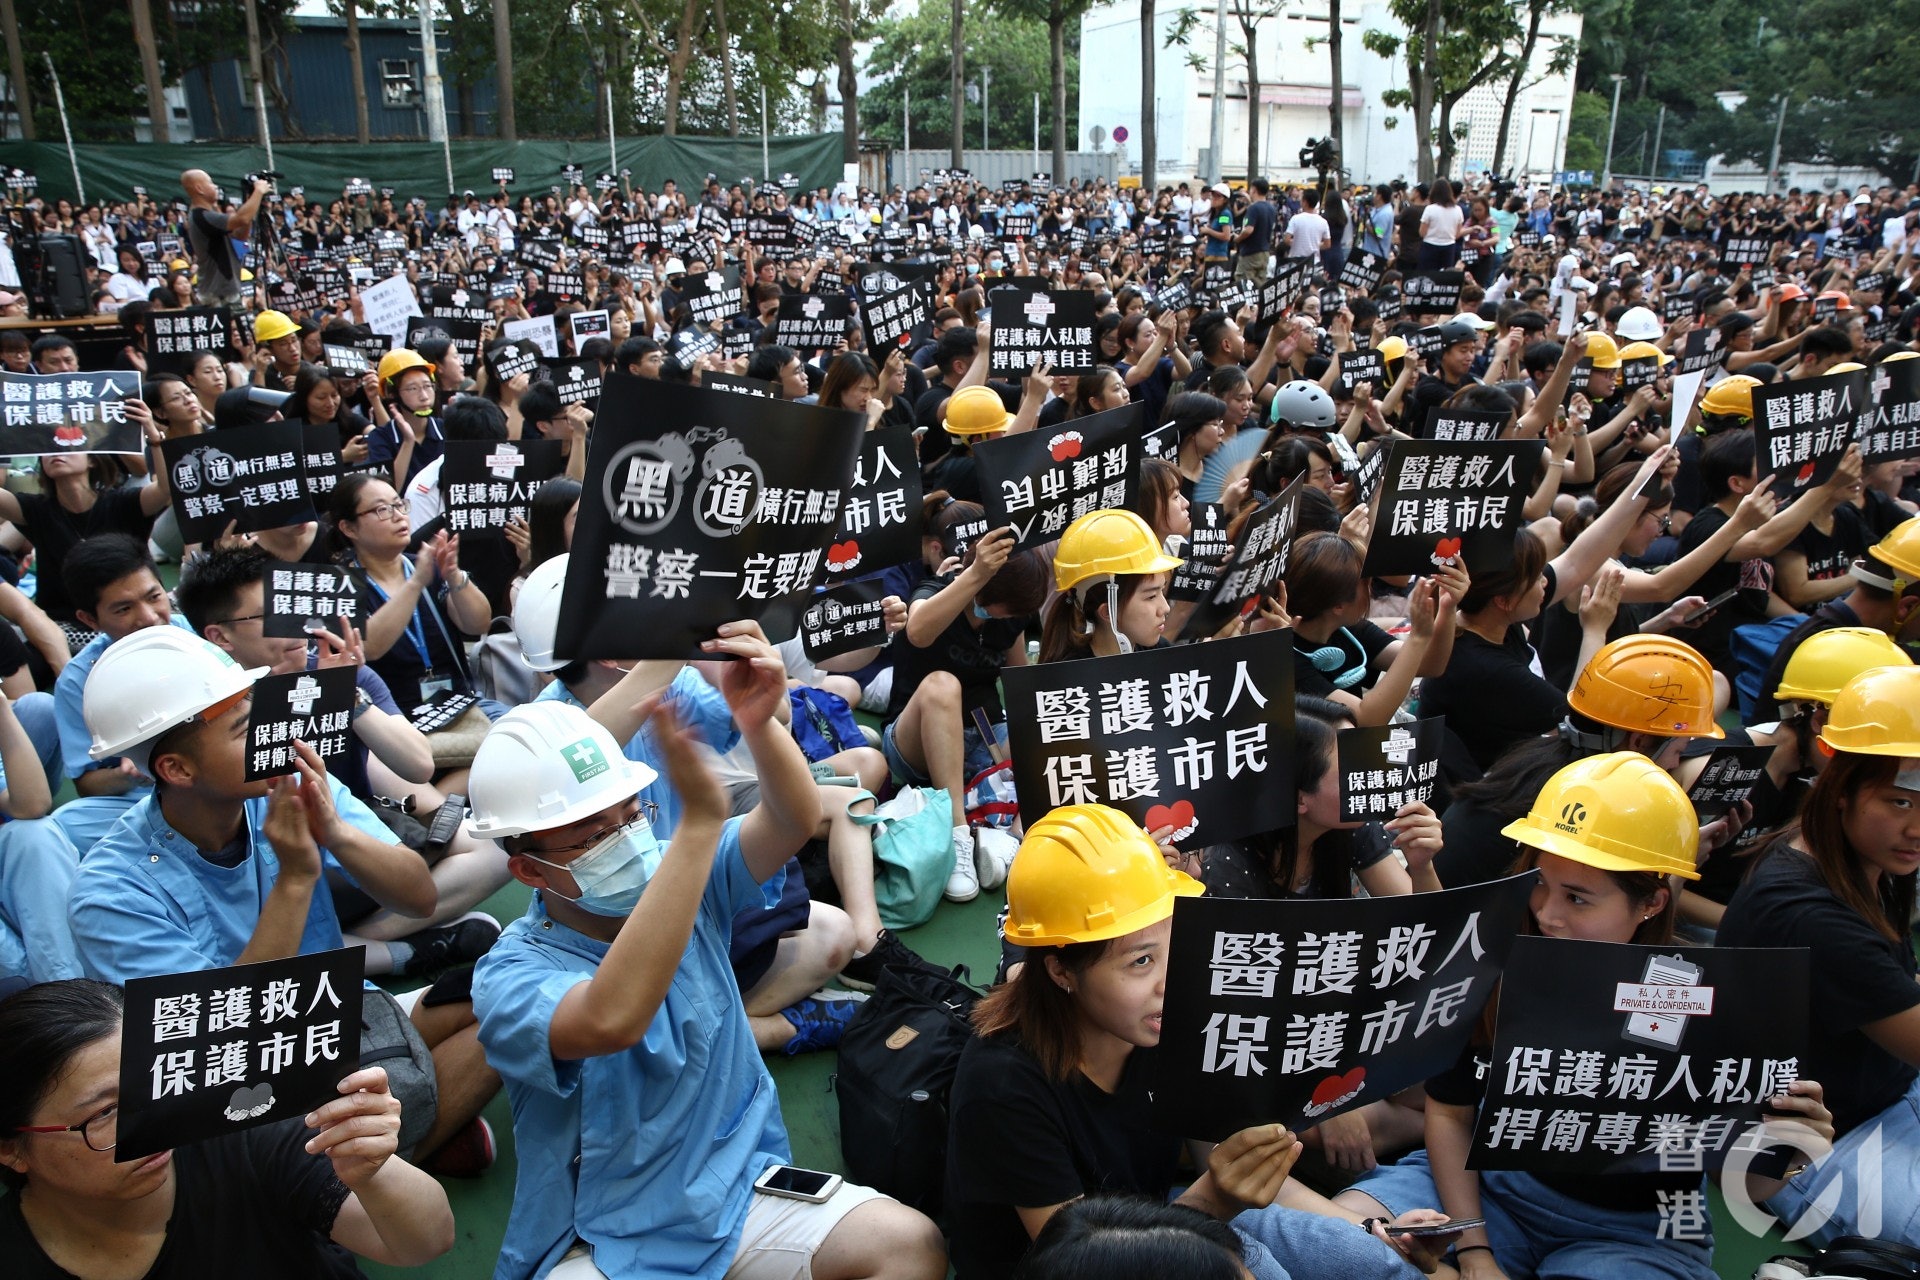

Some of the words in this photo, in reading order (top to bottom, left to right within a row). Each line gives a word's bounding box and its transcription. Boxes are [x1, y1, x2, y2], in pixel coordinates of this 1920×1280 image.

[154, 313, 224, 335] 醫護救人
[868, 287, 922, 327] 醫護救人
[156, 334, 225, 353] 保護市民
[873, 305, 926, 346] 保護市民
[993, 326, 1093, 347] 保護病人私隱
[992, 348, 1093, 370] 捍衛專業自主
[3, 378, 125, 402] 醫護救人
[1766, 385, 1853, 430] 醫護救人
[3, 400, 128, 426] 保護市民
[303, 452, 336, 469] 無忌
[1769, 422, 1849, 469] 保護市民
[177, 452, 296, 490] 黑道橫行無忌
[1397, 453, 1517, 492] 醫護救人
[184, 479, 300, 519] 警察一定要理
[449, 481, 547, 506] 保護病人私
[617, 456, 841, 525] 黑道橫行無忌
[449, 506, 531, 531] 捍衛專業
[1390, 495, 1510, 537] 保護市民
[272, 569, 357, 595] 醫護救人
[603, 542, 823, 601] 警察一定要理
[273, 594, 357, 620] 保護市民
[807, 600, 882, 628] 黑道橫行無忌
[809, 617, 880, 648] 警察一定要理
[1035, 660, 1269, 744] 醫護救人
[254, 709, 350, 747] 保護病人私隱
[1042, 722, 1269, 808] 保護市民
[1347, 758, 1439, 792] 保護病人私隱
[1347, 781, 1435, 815] 捍衛專業自主
[1554, 822, 1579, 835] KOREL
[1208, 911, 1487, 998] 醫護救人
[152, 970, 343, 1044] 醫護救人
[1620, 998, 1651, 1009] PRIVATE
[1651, 1001, 1657, 1009] &
[1658, 1000, 1706, 1011] CONFIDENTIAL
[1639, 987, 1690, 1000] 私人密件
[1200, 975, 1475, 1077] 保護市民
[149, 1019, 342, 1101] 保護市民
[1504, 1046, 1800, 1105] 保護病人私隱
